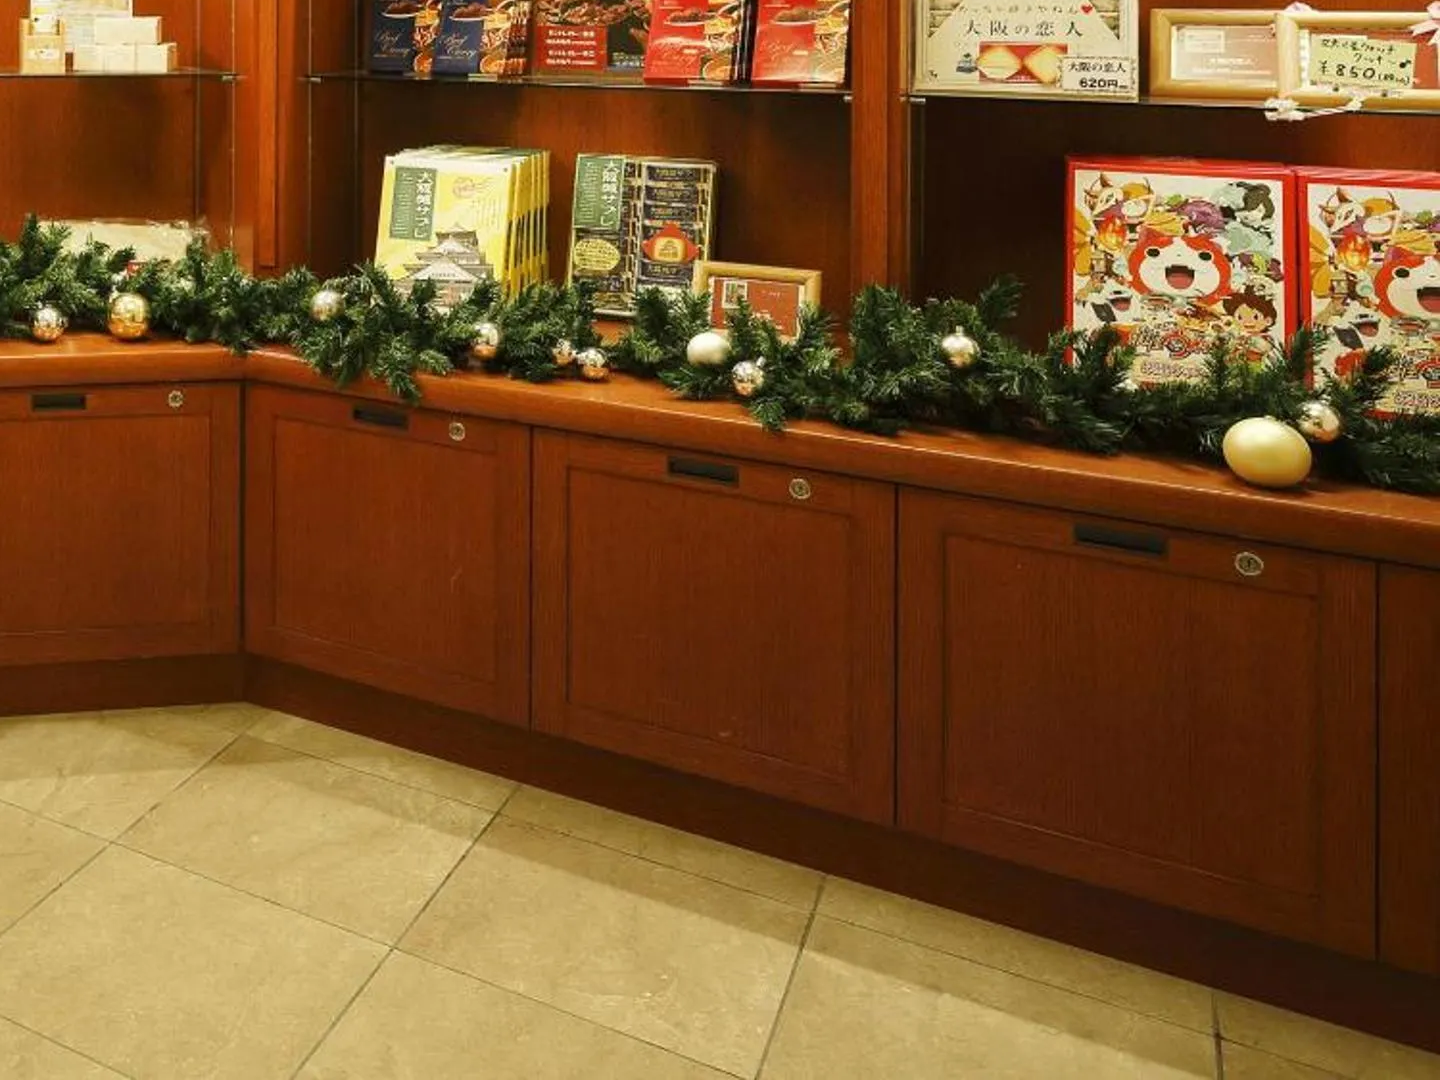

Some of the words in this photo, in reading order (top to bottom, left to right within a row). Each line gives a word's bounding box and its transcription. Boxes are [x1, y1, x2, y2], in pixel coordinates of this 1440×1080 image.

[964, 19, 1083, 38] 大阪の恋人
[1067, 61, 1127, 73] 大阪の恋人
[1079, 77, 1119, 88] 620円
